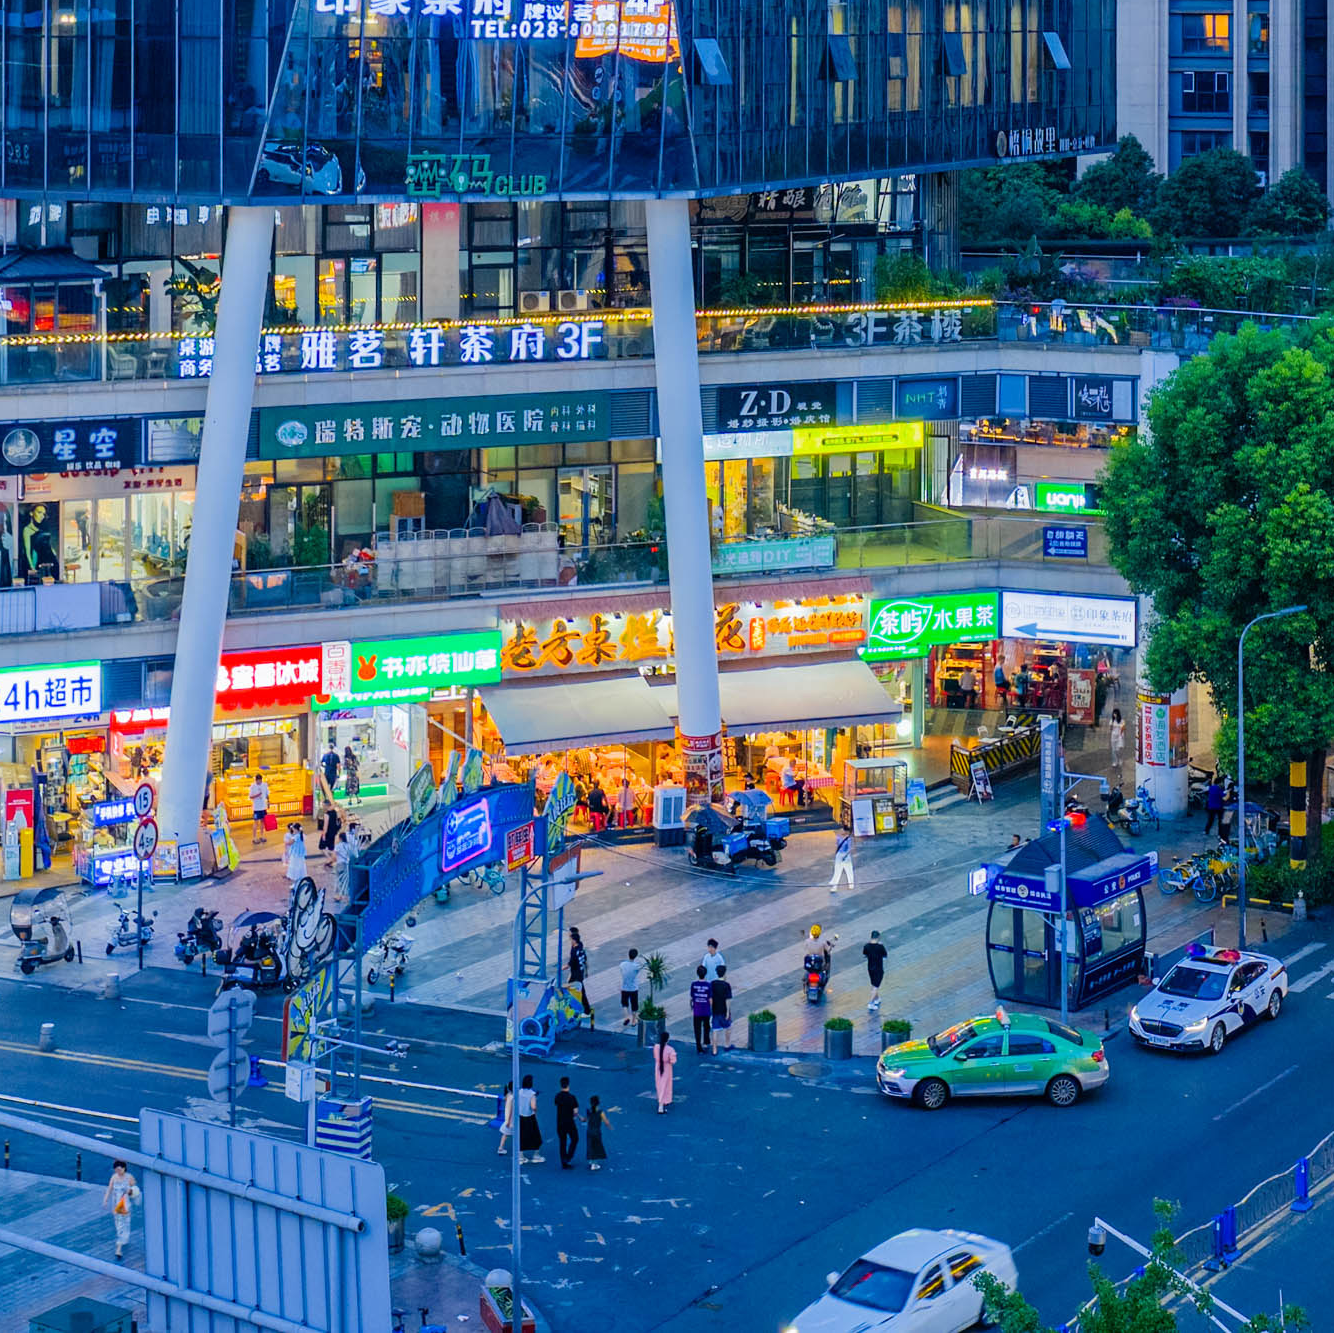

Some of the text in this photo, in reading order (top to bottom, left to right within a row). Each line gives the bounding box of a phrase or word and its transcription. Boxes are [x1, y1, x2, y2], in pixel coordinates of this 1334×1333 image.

[846, 309, 964, 348] 3F茶楼
[300, 321, 604, 369] 雅茗轩茶府3F
[179, 358, 213, 378] 商务
[905, 391, 936, 404] NHT
[52, 427, 118, 460] 星空
[932, 604, 994, 631] 水果茶
[231, 658, 319, 690] 蜜雪冰城
[381, 648, 497, 677] 书亦烧仙草
[138, 792, 149, 809] 15
